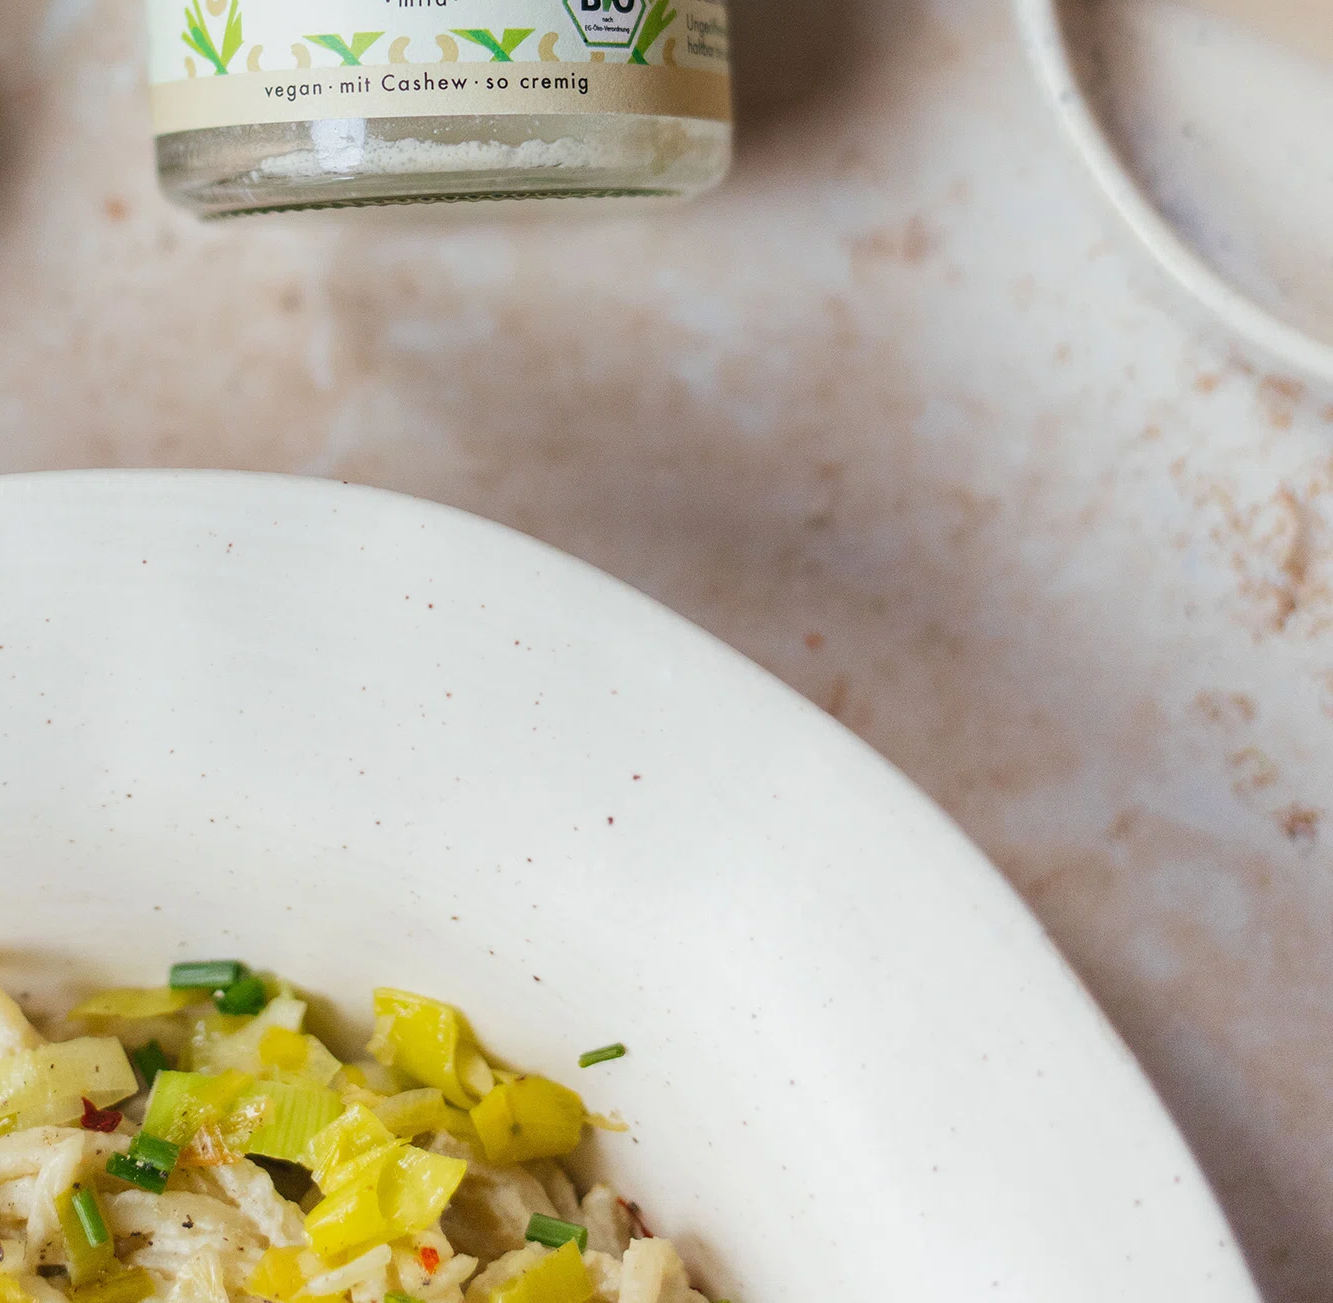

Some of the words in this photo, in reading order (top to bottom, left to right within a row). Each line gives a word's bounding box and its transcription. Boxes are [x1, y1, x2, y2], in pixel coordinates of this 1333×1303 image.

[264, 80, 323, 101] vegan
[340, 76, 370, 93] mit
[381, 72, 467, 92] Cashew
[486, 77, 509, 90] so
[520, 72, 589, 95] cremig
